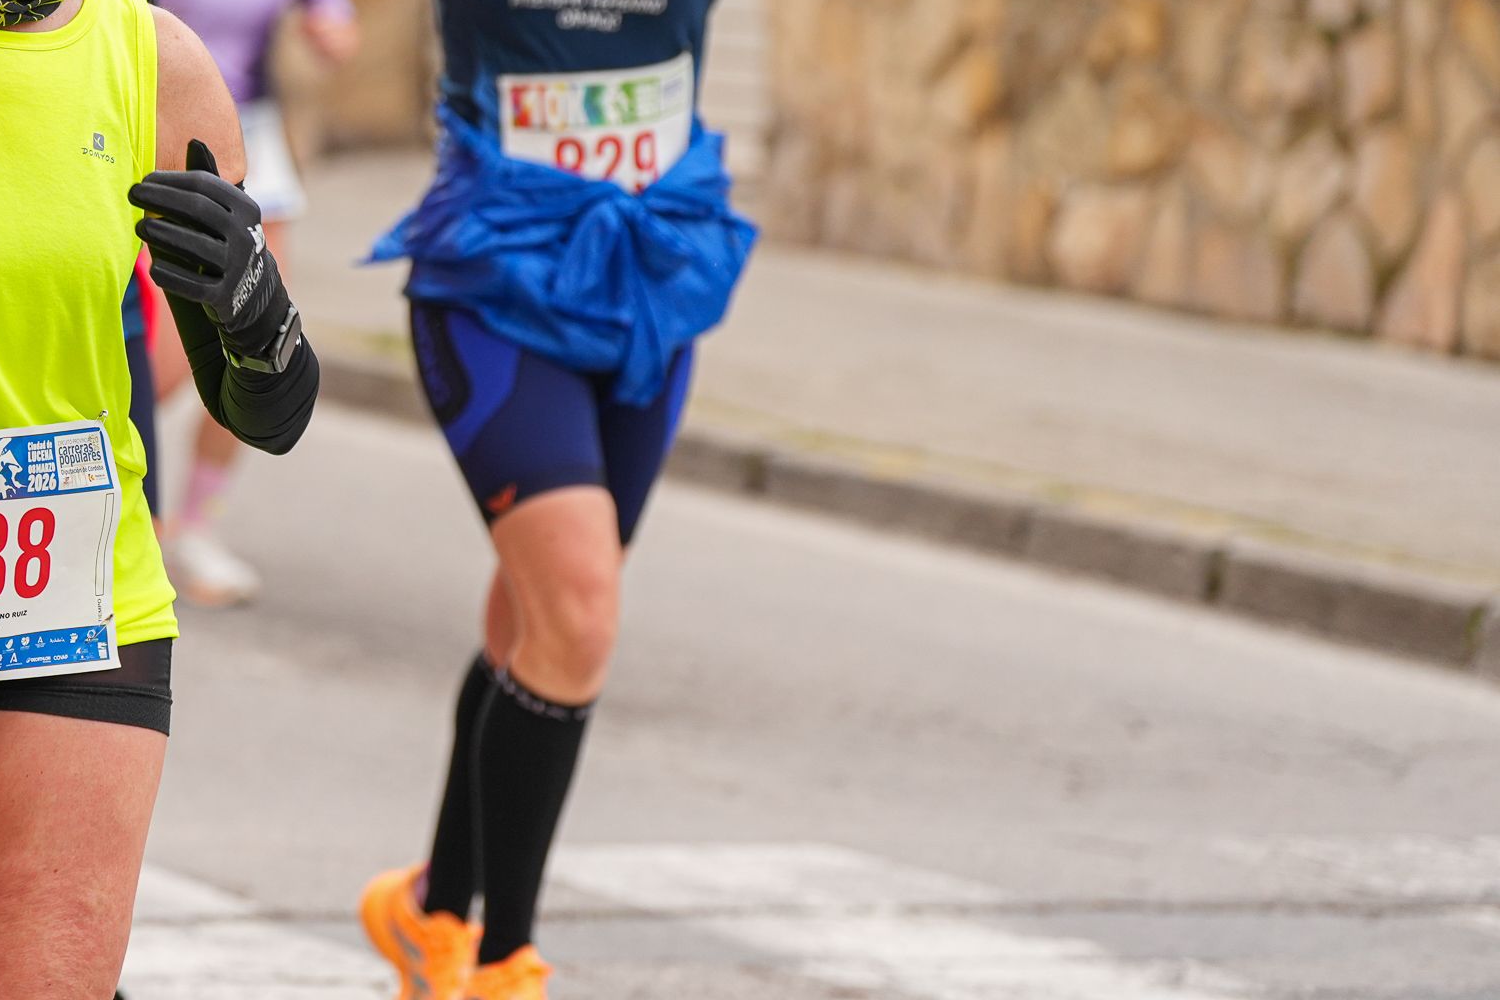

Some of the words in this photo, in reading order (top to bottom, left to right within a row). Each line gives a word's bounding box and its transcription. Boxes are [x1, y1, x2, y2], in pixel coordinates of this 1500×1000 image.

[81, 147, 115, 164] DOMYOS
[27, 449, 54, 462] LUCENA
[58, 442, 94, 456] carreras
[59, 451, 102, 468] populares
[27, 473, 58, 493] 2026
[11, 610, 28, 618] RUIZ
